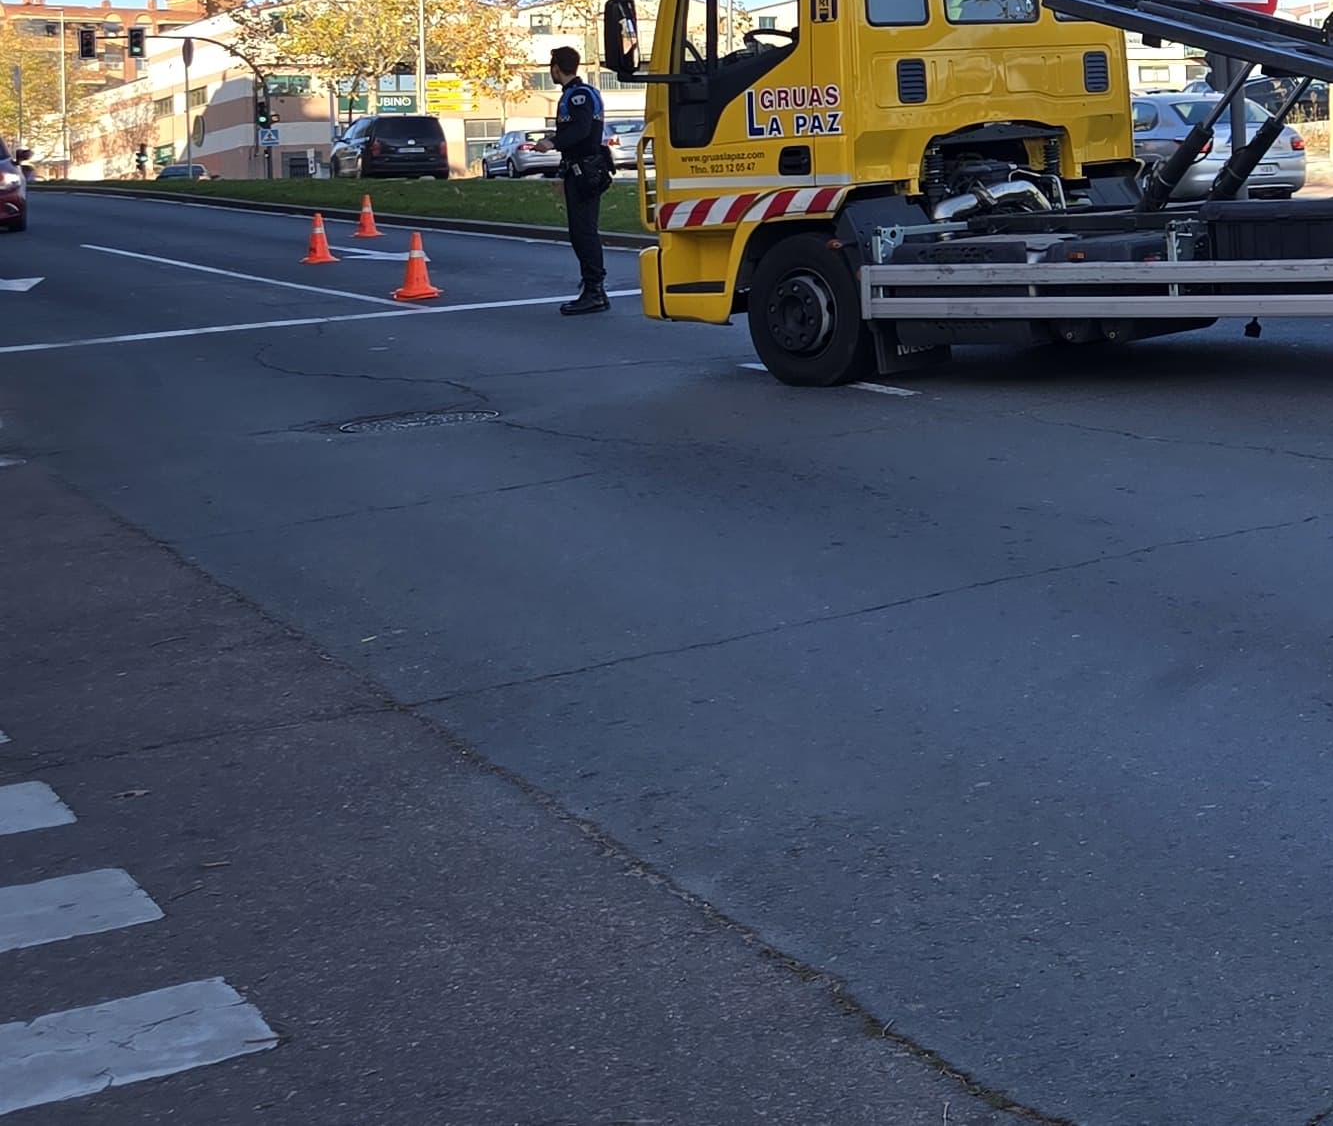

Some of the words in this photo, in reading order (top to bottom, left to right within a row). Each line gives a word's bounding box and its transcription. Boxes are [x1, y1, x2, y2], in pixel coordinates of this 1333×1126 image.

[760, 85, 839, 110] GRUAS
[746, 90, 783, 137] LA
[794, 112, 841, 135] PAZ
[681, 151, 765, 163] www.gruaslapaz.com
[711, 164, 724, 173] 923
[726, 163, 734, 172] 12
[746, 162, 756, 171] 47
